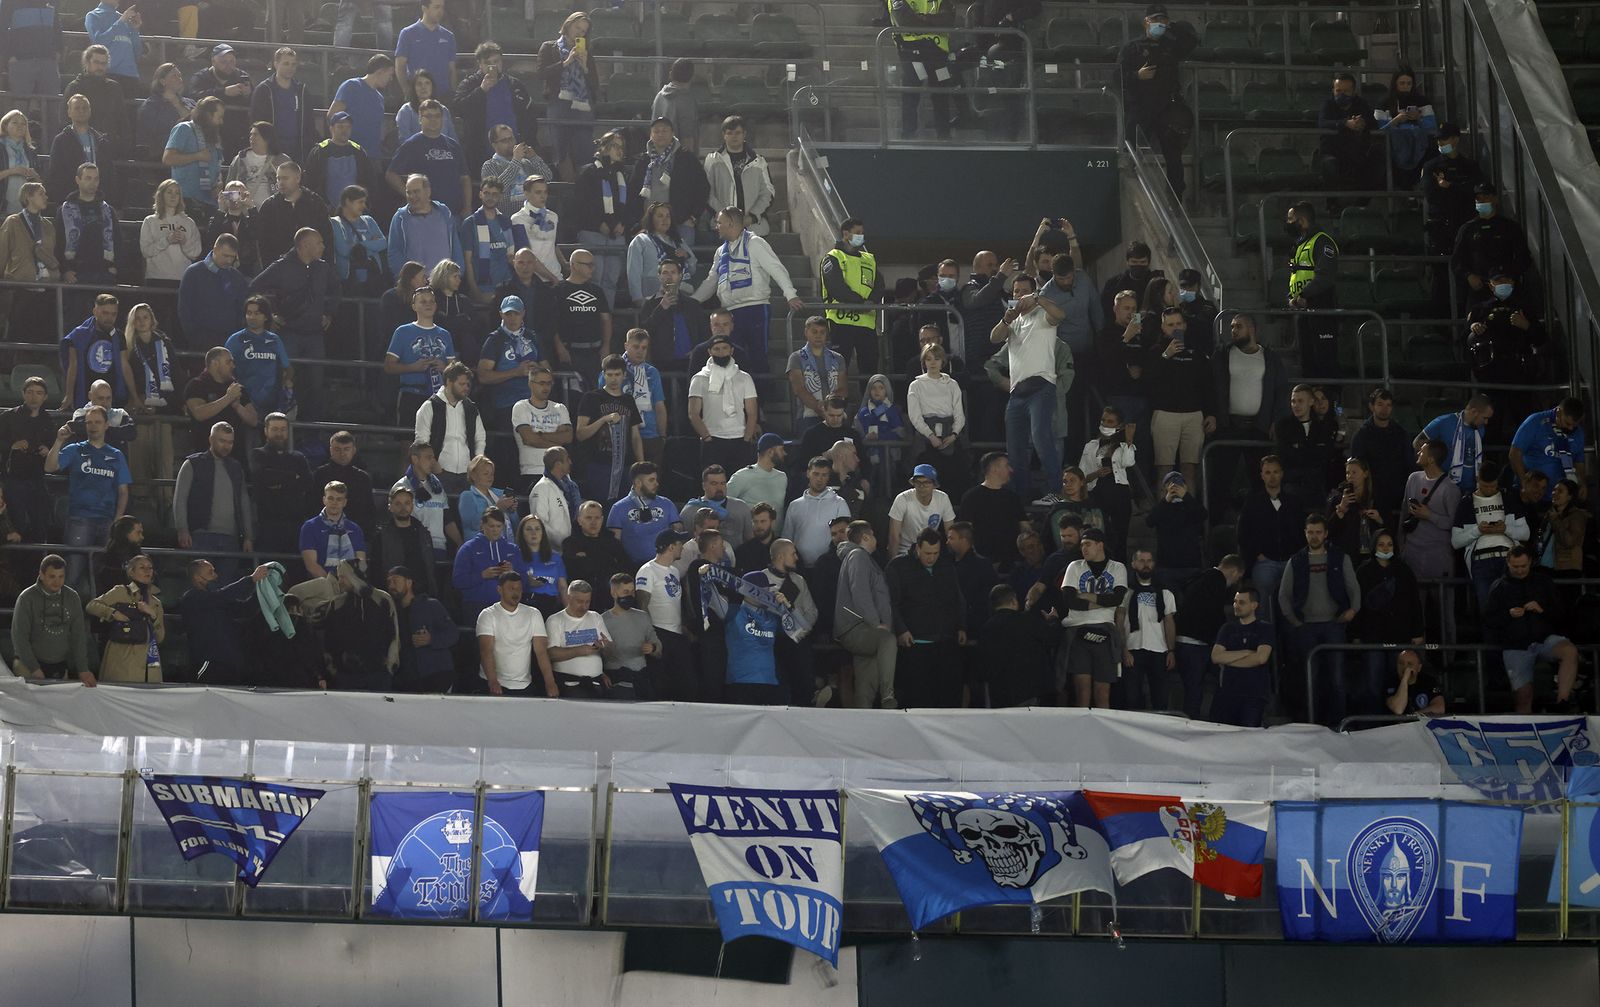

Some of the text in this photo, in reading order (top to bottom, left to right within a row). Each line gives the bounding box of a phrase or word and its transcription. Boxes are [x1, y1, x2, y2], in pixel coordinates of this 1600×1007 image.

[1087, 160, 1110, 168] A 221
[569, 305, 597, 313] umbro
[681, 793, 839, 834] ZENIT
[180, 836, 209, 852] FOR
[1363, 833, 1424, 874] NEVSKY FRONT
[440, 852, 473, 878] The
[745, 844, 819, 883] ON
[413, 872, 498, 907] Trols
[1297, 858, 1341, 920] N
[1445, 859, 1492, 922] F
[723, 888, 840, 953] TOUR
